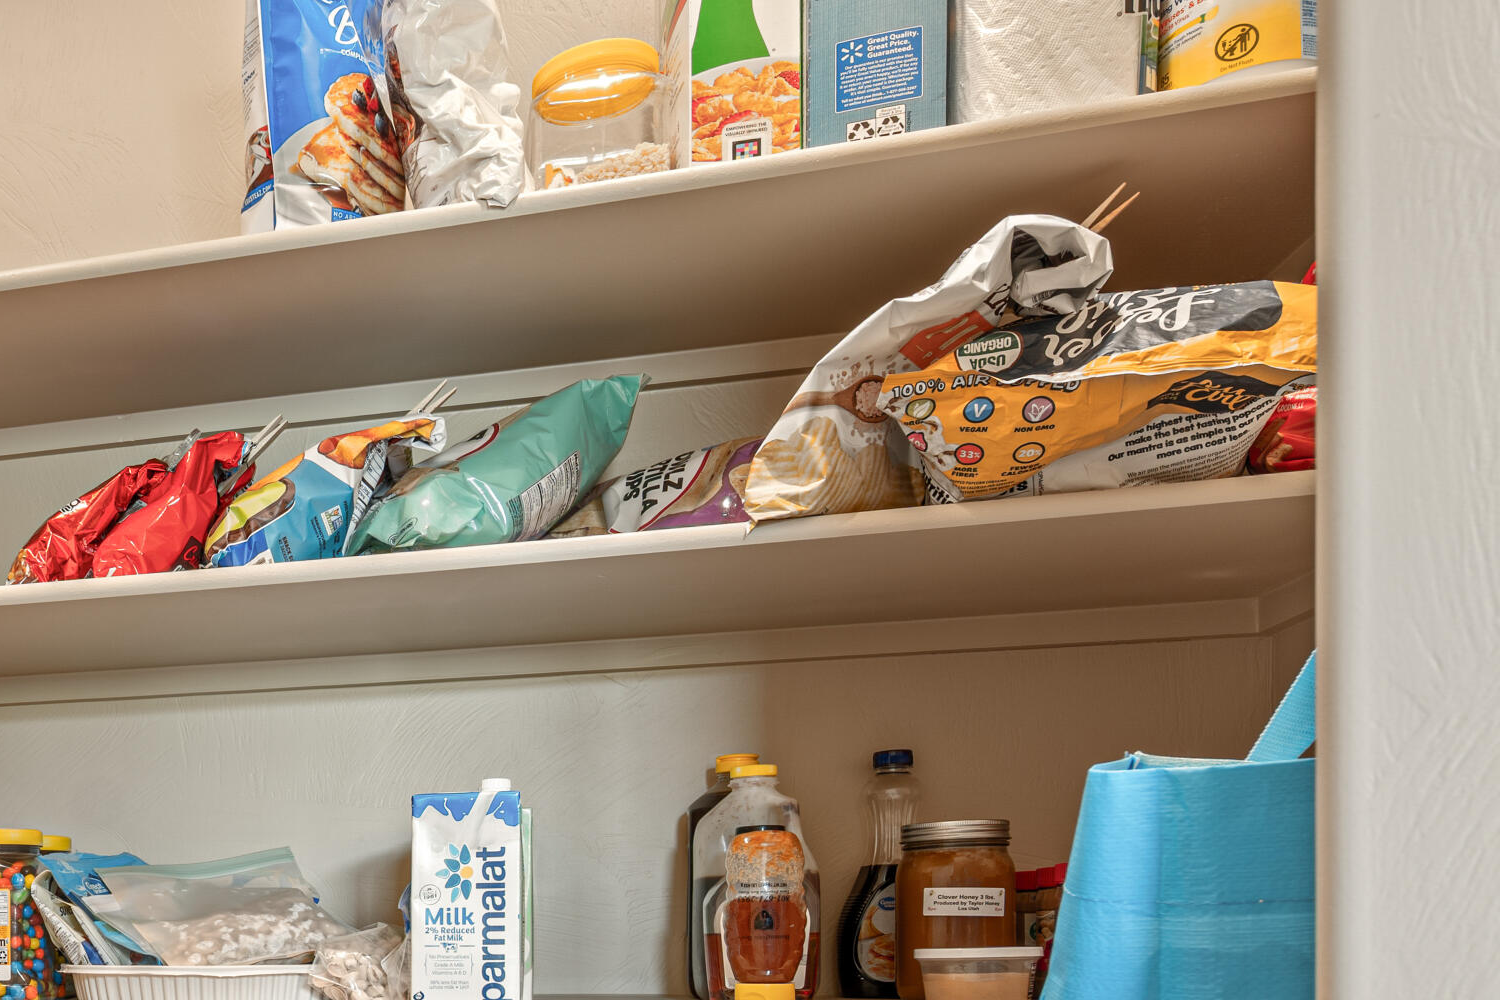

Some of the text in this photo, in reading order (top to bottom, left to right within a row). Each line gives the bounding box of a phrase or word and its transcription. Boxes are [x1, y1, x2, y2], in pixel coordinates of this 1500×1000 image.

[889, 30, 919, 40] Quality.
[867, 44, 914, 58] Guaranteed.
[963, 336, 1012, 354] ORGANIC
[970, 353, 1008, 368] USDA
[892, 374, 990, 398] 100% AIR
[1034, 424, 1056, 432] GMO
[1124, 416, 1231, 447] make the best tasting
[1146, 416, 1183, 432] highest
[1108, 427, 1224, 462] Our mantra simple
[1156, 438, 1228, 460] more can cost
[959, 450, 981, 459] 33%
[424, 907, 475, 926] Milk
[424, 926, 476, 934] 2% Reduced
[434, 934, 464, 942] Fat Milk
